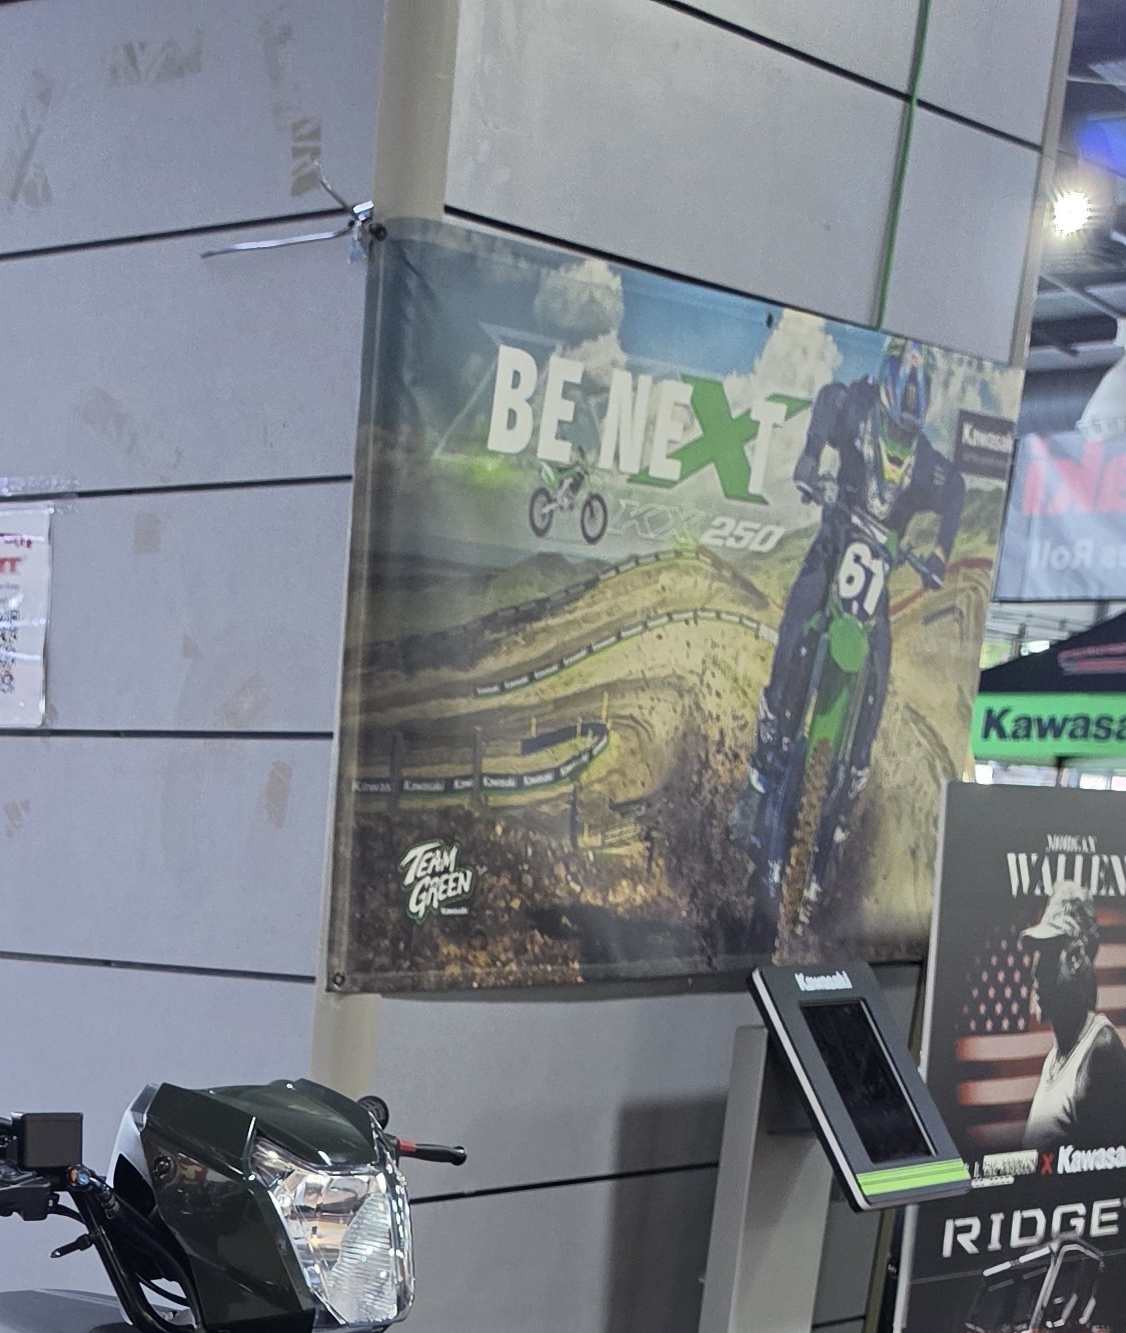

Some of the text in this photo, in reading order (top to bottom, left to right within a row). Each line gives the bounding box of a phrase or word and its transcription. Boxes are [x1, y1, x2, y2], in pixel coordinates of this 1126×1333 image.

[487, 344, 812, 506] BE NEXT
[698, 516, 787, 553] 250
[838, 541, 884, 617] 61
[400, 842, 459, 887] TEAM
[409, 869, 474, 918] GREEN
